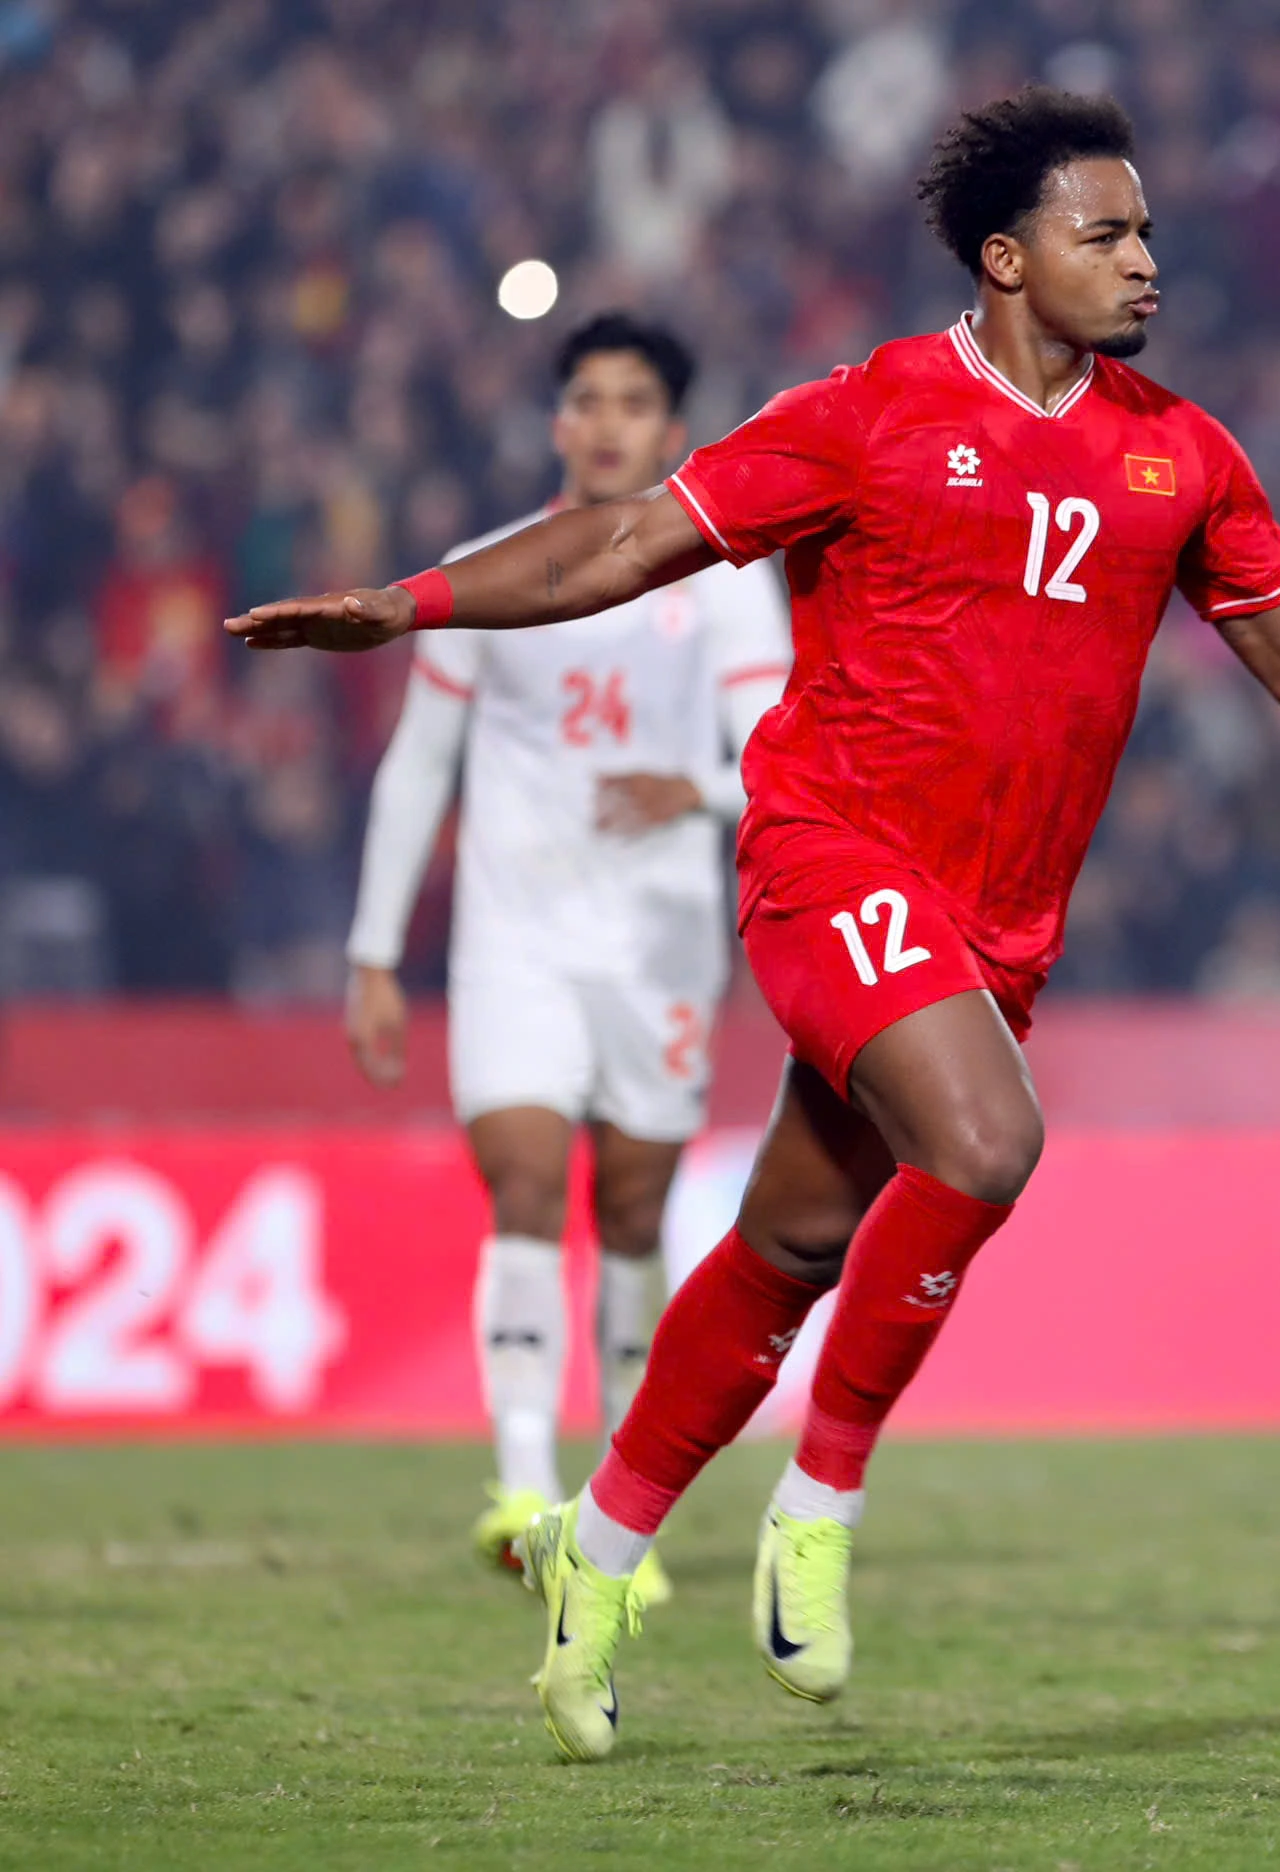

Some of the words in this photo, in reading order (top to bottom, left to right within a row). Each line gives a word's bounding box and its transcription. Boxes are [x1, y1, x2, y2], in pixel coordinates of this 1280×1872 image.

[1023, 491, 1100, 603] 12
[559, 668, 634, 747] 24
[829, 888, 932, 986] 12
[0, 1165, 342, 1412] 24
